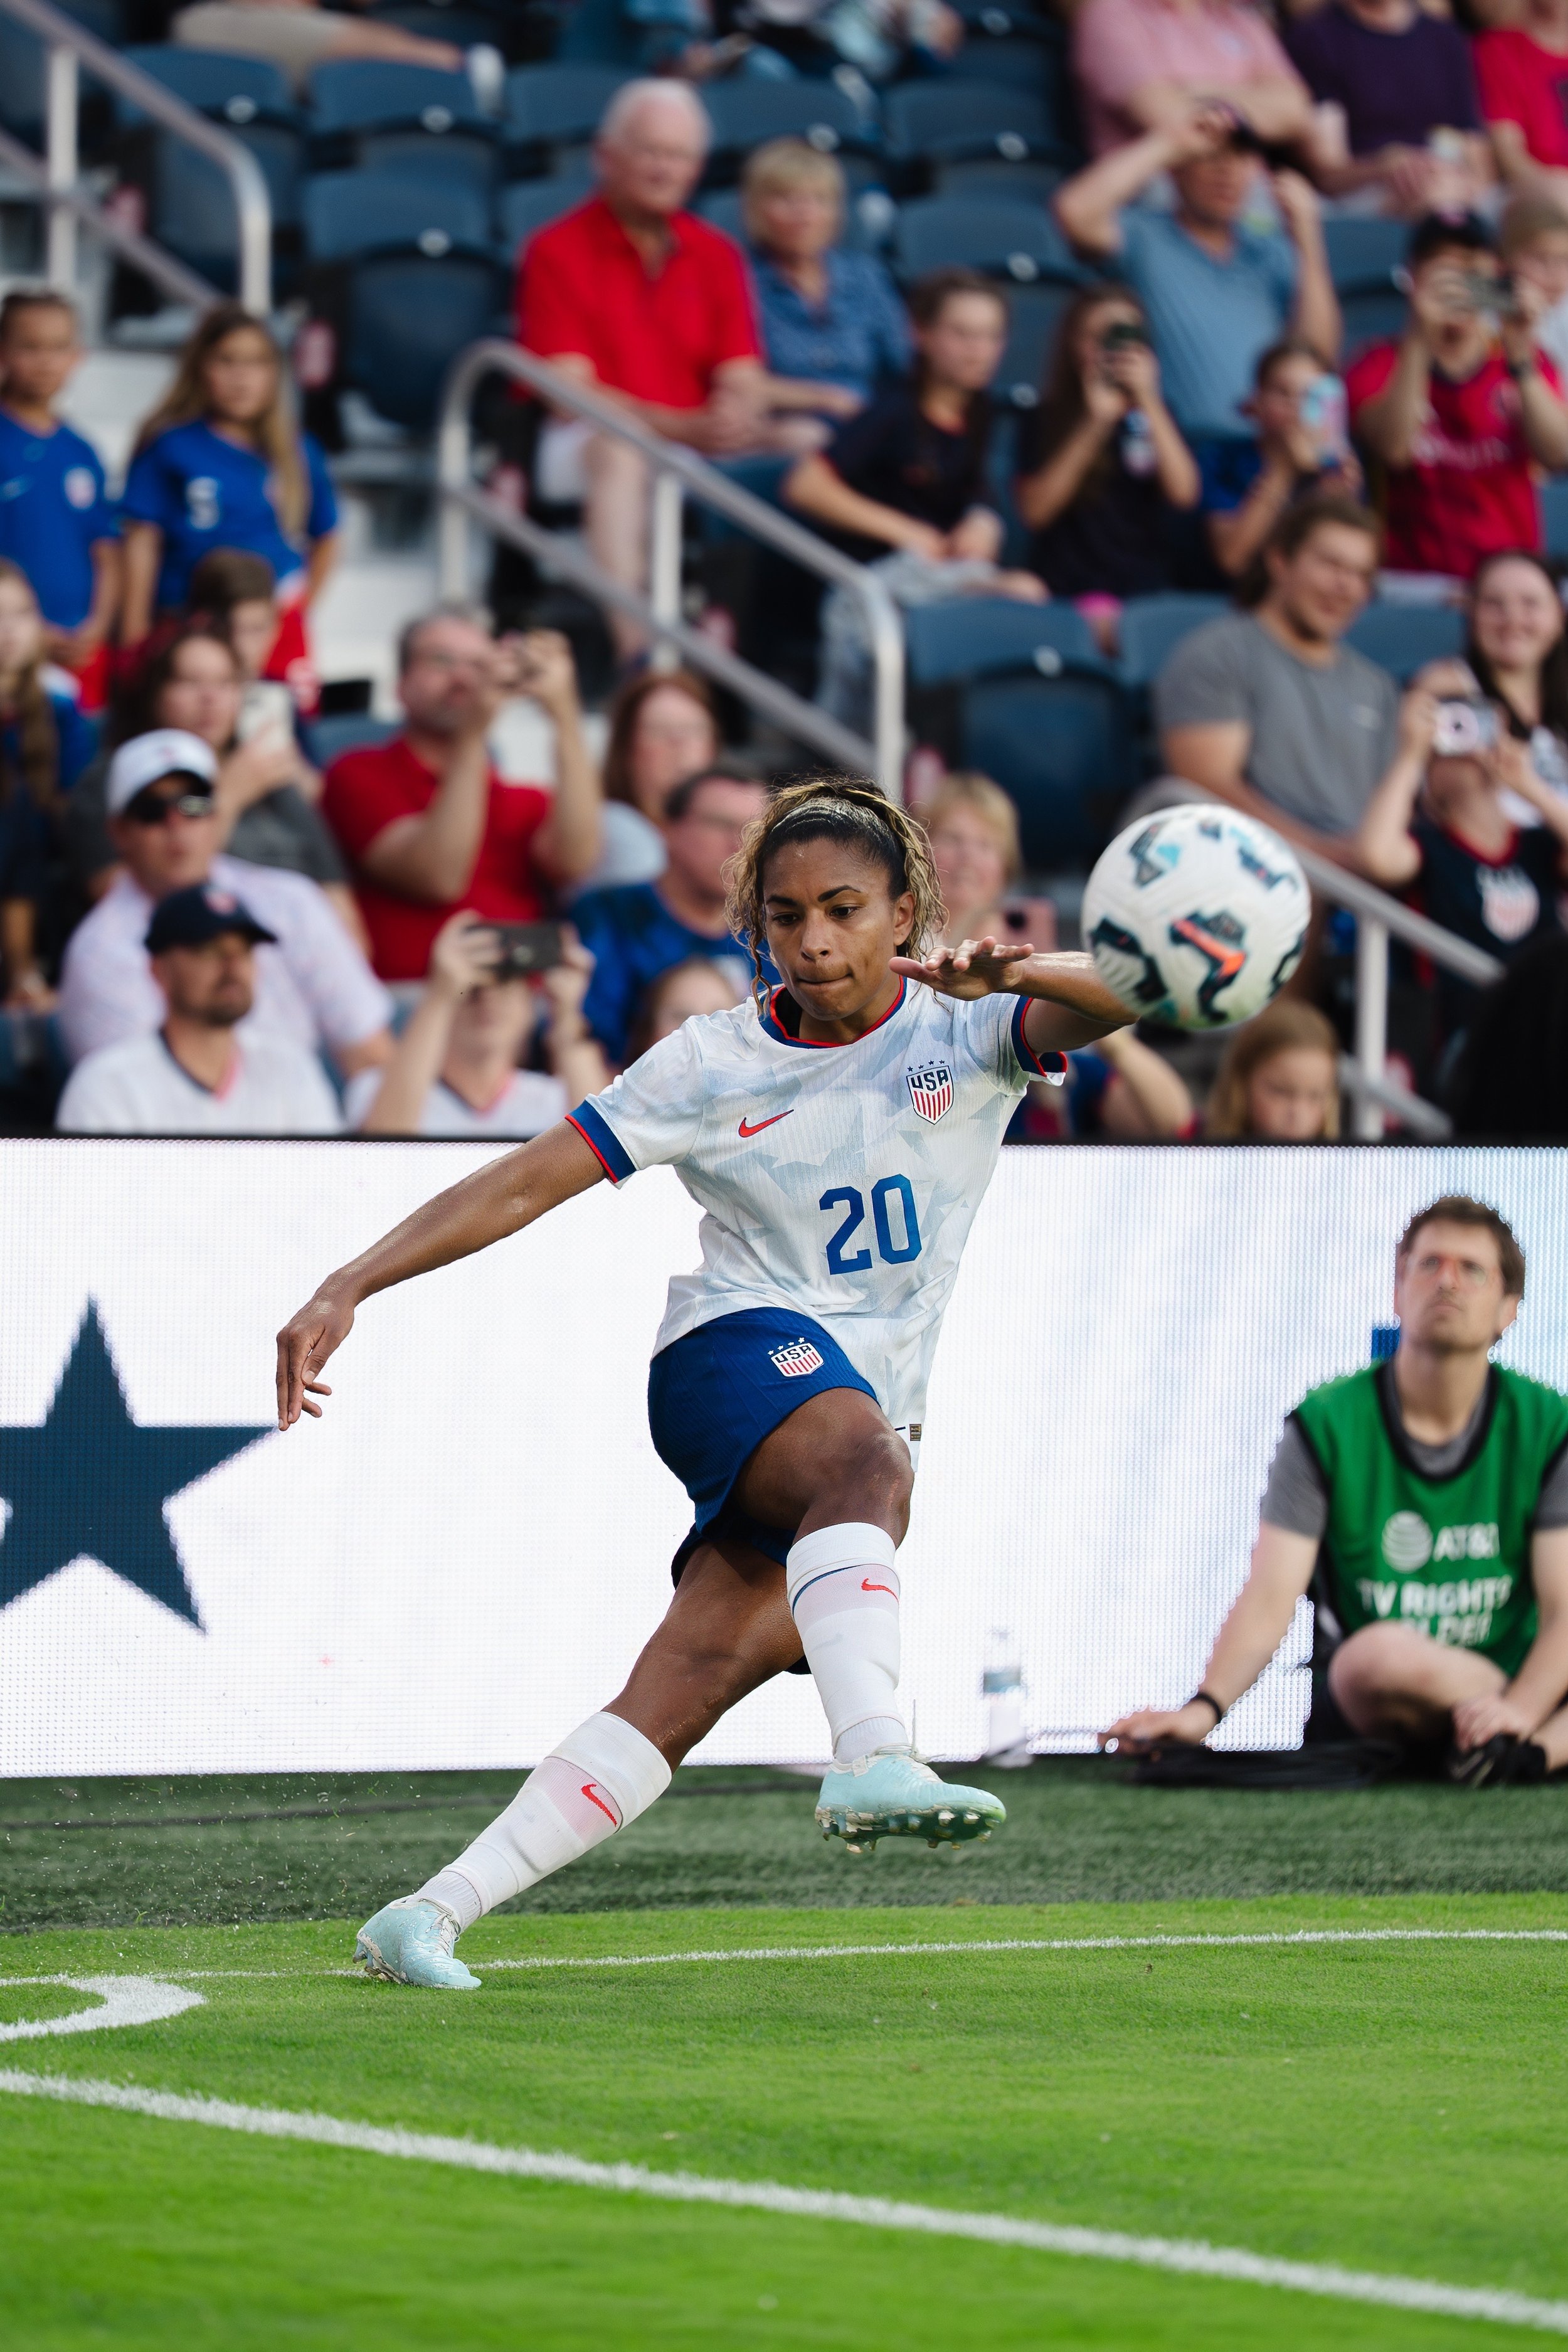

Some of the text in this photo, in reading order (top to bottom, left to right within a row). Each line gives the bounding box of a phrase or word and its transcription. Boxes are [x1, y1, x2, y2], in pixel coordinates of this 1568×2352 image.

[911, 1069, 948, 1091] USA
[819, 1173, 922, 1275] 20
[775, 1345, 812, 1363] USA
[1356, 1577, 1397, 1617] TV
